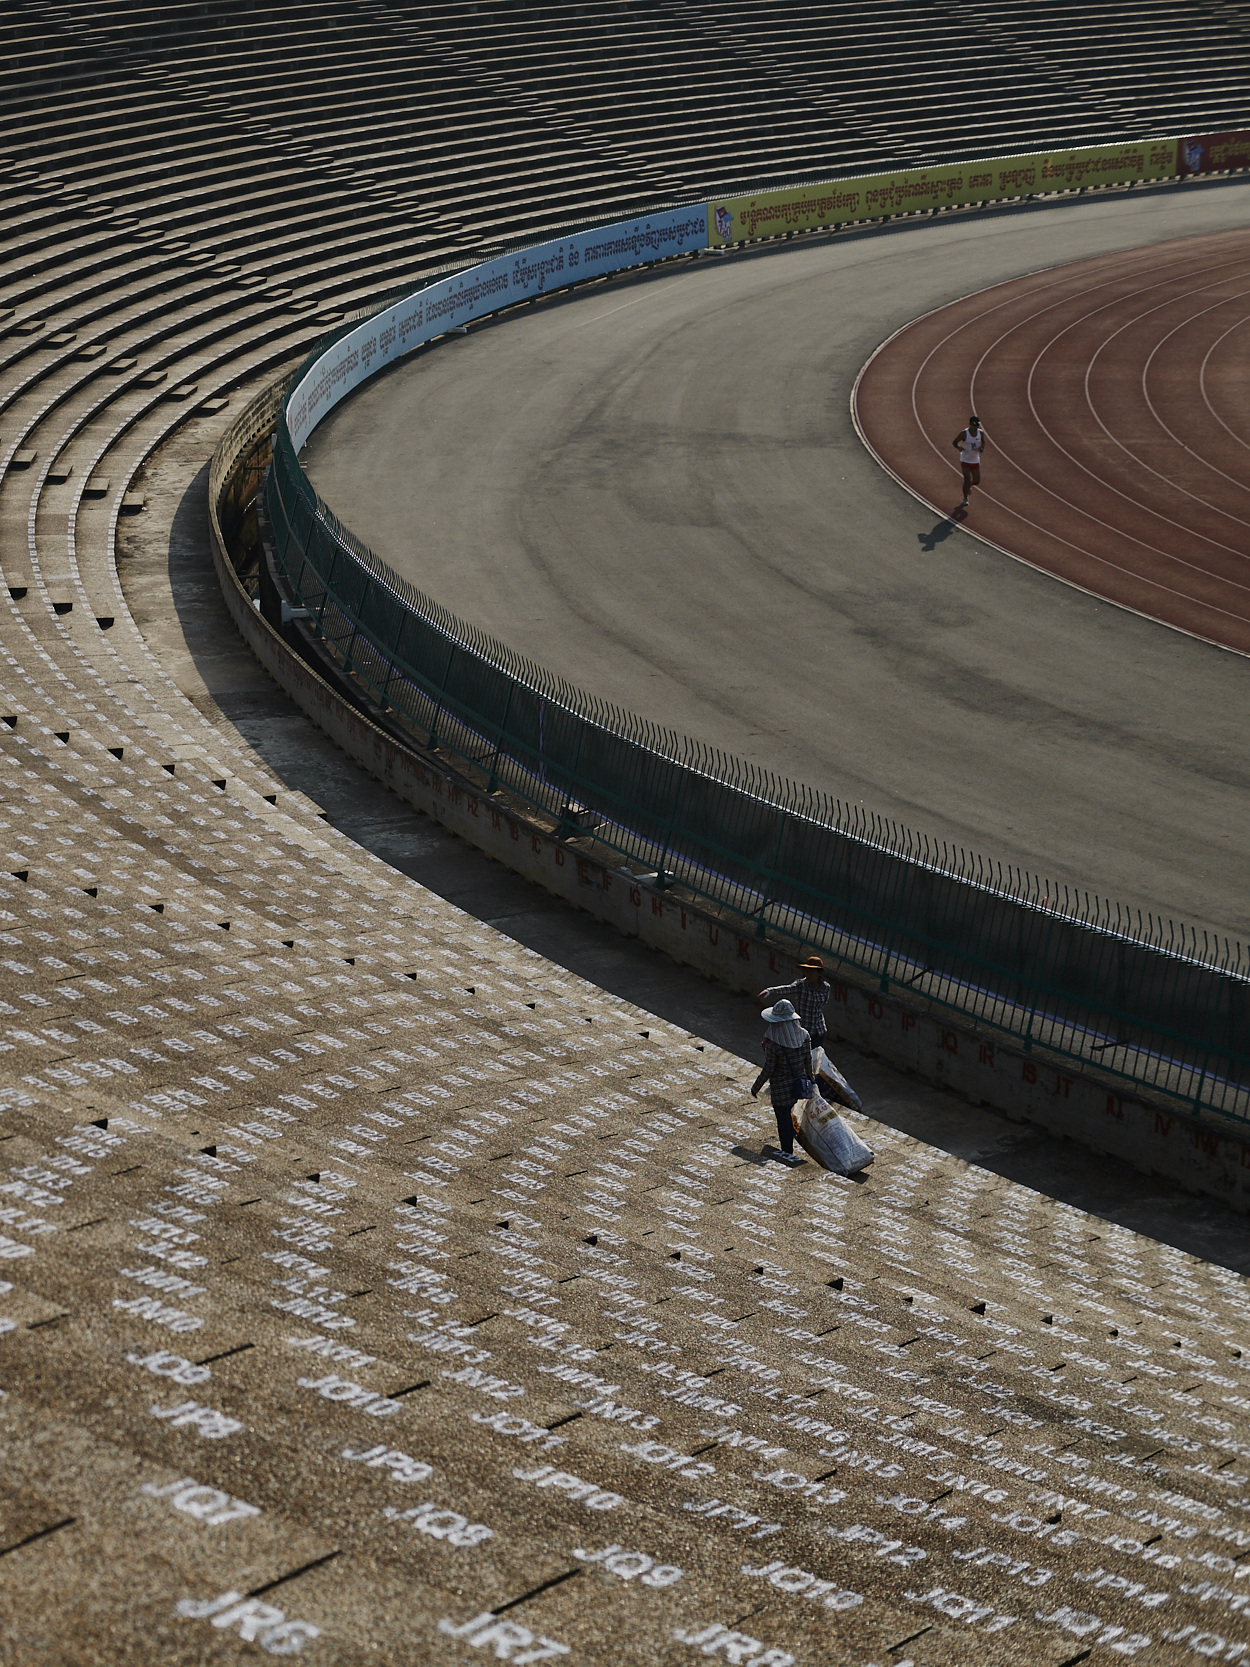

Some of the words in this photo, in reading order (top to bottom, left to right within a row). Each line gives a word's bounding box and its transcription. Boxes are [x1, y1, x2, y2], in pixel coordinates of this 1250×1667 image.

[468, 797, 479, 818] HZ
[491, 812, 502, 832] IA
[531, 835, 542, 855] IC
[555, 847, 565, 868] ID
[629, 886, 641, 907] IG
[652, 897, 662, 917] IH
[834, 983, 848, 1005] IN
[868, 999, 883, 1020] IO
[901, 1011, 916, 1032] IP
[941, 1028, 958, 1055] IQ
[979, 1044, 995, 1069] IR
[1022, 1062, 1037, 1085] IS
[1106, 1095, 1123, 1118] IU
[136, 1241, 208, 1269] JL12
[120, 1266, 206, 1298] JM11
[271, 1276, 349, 1305] JL13
[112, 1296, 205, 1332] JN10
[270, 1297, 356, 1330] JM12
[403, 1309, 478, 1338] JL14
[285, 1335, 377, 1368] JN11
[405, 1330, 494, 1365] JM13
[527, 1333, 599, 1361] JL15
[126, 1350, 212, 1385] JO9
[441, 1366, 525, 1401] JN12
[538, 1364, 621, 1396] JM14
[640, 1361, 711, 1389] JL16
[297, 1373, 403, 1416] JO10
[660, 1386, 743, 1418] JM15
[747, 1382, 819, 1409] JL17
[149, 1401, 244, 1439] JP8
[572, 1396, 662, 1431] JN13
[770, 1412, 851, 1445] JM16
[847, 1404, 915, 1432] JL18
[470, 1411, 566, 1450] JO11
[700, 1426, 788, 1460] JN14
[877, 1433, 954, 1461] JM17
[937, 1426, 1003, 1451] JL19
[341, 1444, 434, 1483] JP9
[619, 1440, 716, 1480] JO12
[817, 1446, 906, 1480] JN15
[141, 1478, 261, 1526] JQ7
[512, 1465, 625, 1511] JP10
[753, 1467, 847, 1505] JO13
[926, 1471, 1009, 1503] JN16
[383, 1502, 495, 1547] JQ8
[683, 1498, 782, 1538] JP11
[875, 1493, 968, 1530] JO14
[990, 1510, 1080, 1546] JO15
[825, 1524, 928, 1567] JP12
[1091, 1532, 1183, 1570] JO16
[571, 1544, 684, 1588] JQ9
[952, 1546, 1053, 1586] JP13
[741, 1560, 864, 1611] JQ10
[1072, 1566, 1171, 1608] JP14
[176, 1590, 322, 1653] JR6
[903, 1586, 1018, 1633] JQ11
[437, 1611, 571, 1665] JR7
[1035, 1606, 1152, 1656] JQ12
